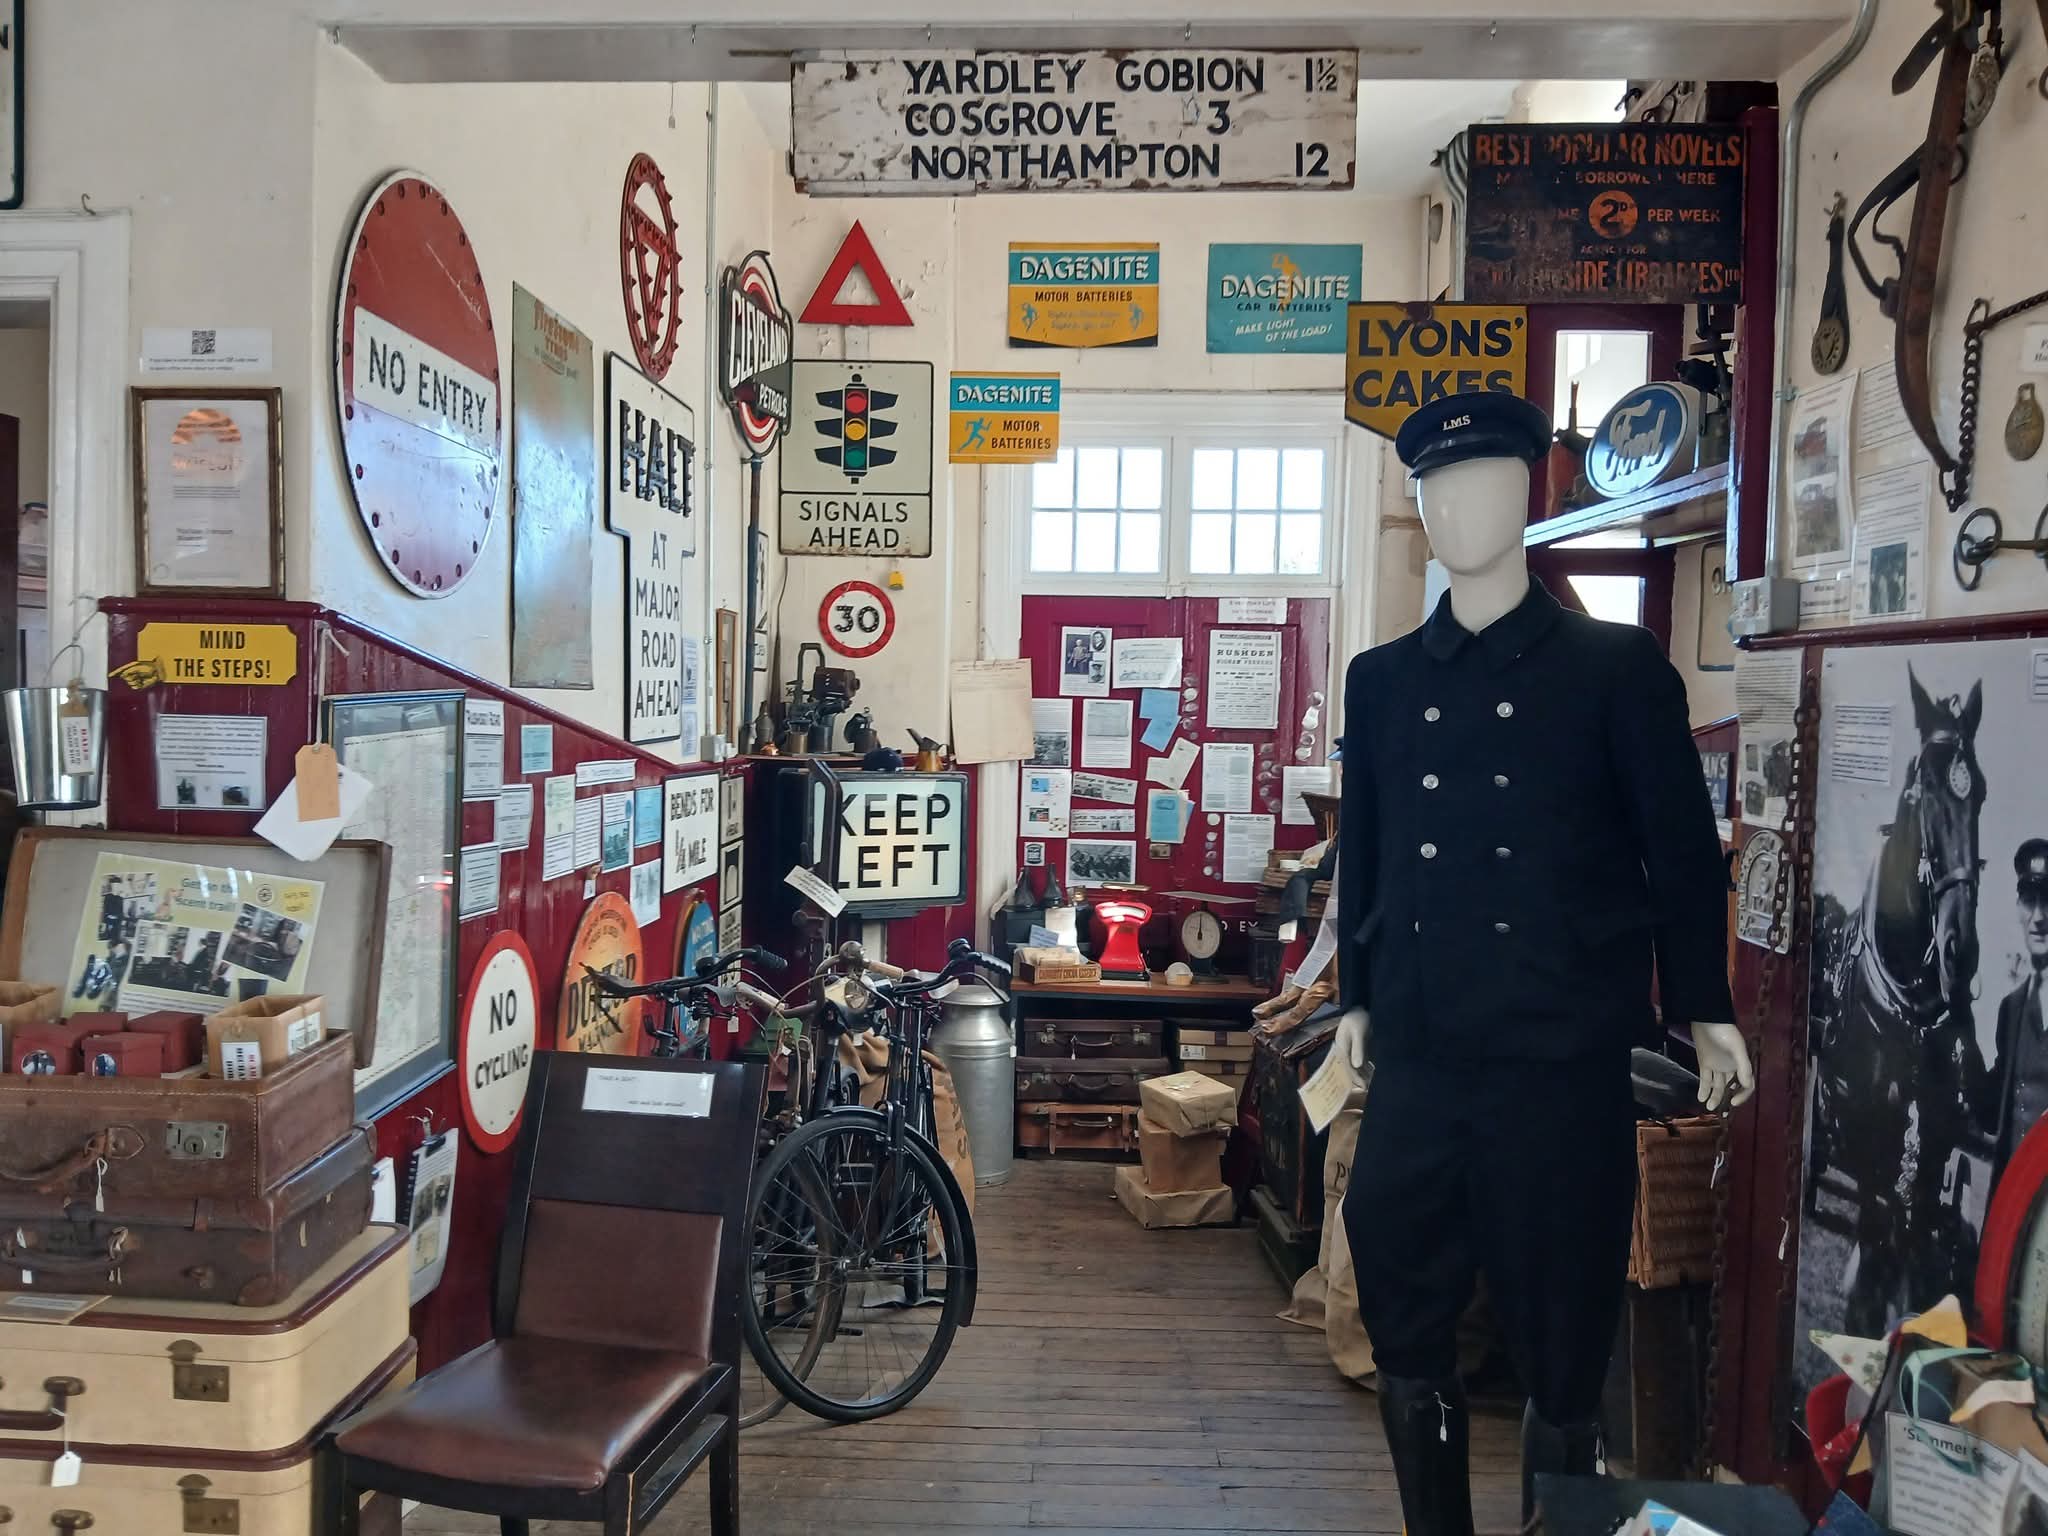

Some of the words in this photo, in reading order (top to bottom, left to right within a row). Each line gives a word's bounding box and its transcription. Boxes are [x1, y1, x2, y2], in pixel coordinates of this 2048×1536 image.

[903, 59, 1085, 95] YARDLEY
[1116, 57, 1264, 92] GOBION
[905, 101, 1117, 136] COSGROVE
[1207, 101, 1231, 134] 3
[911, 142, 1220, 181] NORTHAMPTON
[1296, 143, 1329, 178] 12
[1475, 134, 1532, 166] BEST
[1655, 133, 1741, 166] NOVELS
[1648, 208, 1673, 222] PER
[1678, 209, 1720, 222] WEEK
[1020, 256, 1149, 280] DAGENITE
[1035, 290, 1069, 302] MOTOR
[1076, 290, 1133, 302] BATTERIES
[1221, 274, 1350, 299] DAGENITE
[1237, 302, 1261, 312] CAR
[1269, 302, 1332, 312] BATTERIES
[729, 288, 789, 389] CLEVELAND
[1235, 322, 1263, 336] MAKE
[1266, 318, 1296, 331] LIGHT
[1265, 332, 1278, 342] OF
[1281, 330, 1298, 340] THE
[1358, 316, 1523, 357] LYONS'
[369, 336, 407, 395] NO
[417, 364, 488, 434] ENTRY
[759, 383, 788, 418] PETROLS
[958, 384, 1052, 404] DAGENITE
[1353, 369, 1513, 408] CAKES
[1003, 420, 1040, 432] MOTOR
[1443, 415, 1472, 431] LMS
[619, 399, 696, 518] HALT
[991, 437, 1051, 450] BATTERIES
[799, 500, 908, 523] SIGNALS
[651, 530, 668, 570] AT
[809, 526, 899, 549] AHEAD
[635, 577, 680, 621] MAJOR
[834, 604, 881, 633] 30
[199, 630, 246, 649] MIND
[641, 629, 677, 668] ROAD
[173, 658, 205, 677] THE
[211, 658, 271, 679] STEPS!
[633, 679, 680, 719] AHEAD
[700, 787, 715, 816] FOR
[841, 793, 951, 836] KEEP
[838, 843, 951, 889] EFT
[489, 988, 517, 1034] NO
[474, 1042, 529, 1090] CYCLING
